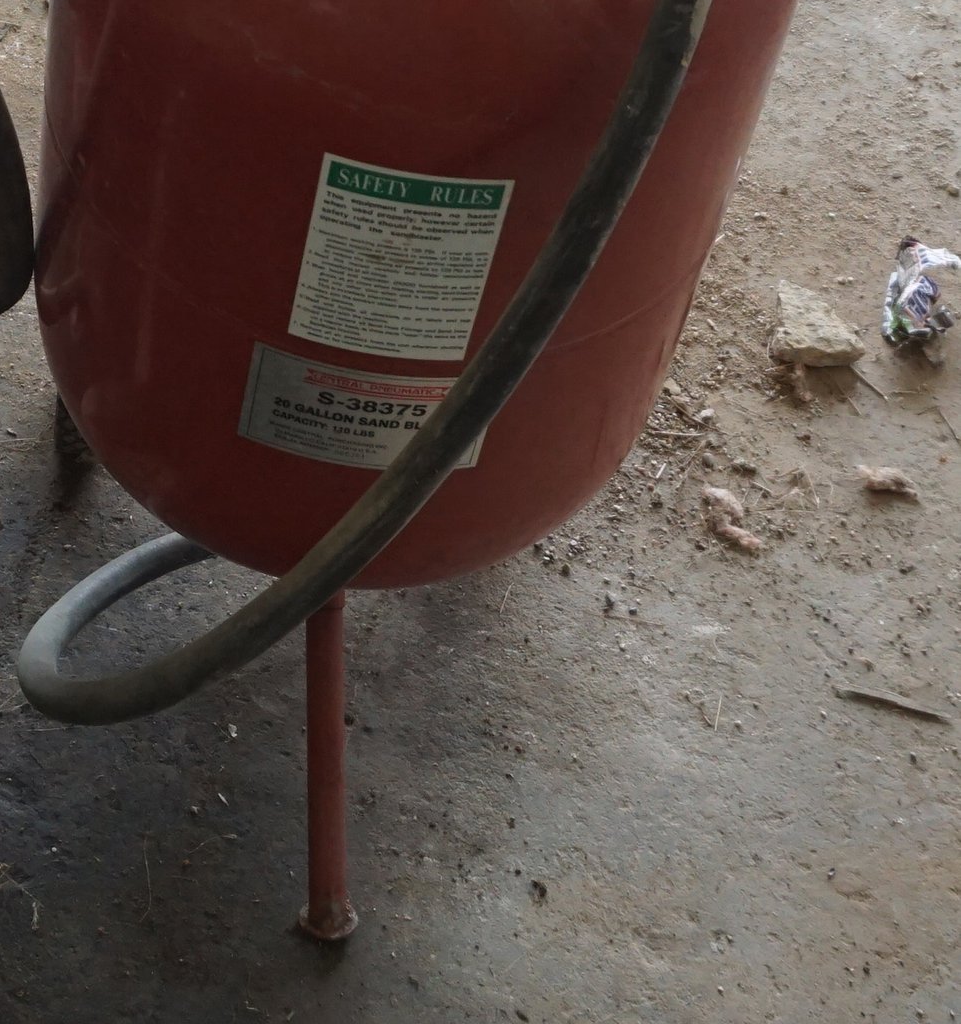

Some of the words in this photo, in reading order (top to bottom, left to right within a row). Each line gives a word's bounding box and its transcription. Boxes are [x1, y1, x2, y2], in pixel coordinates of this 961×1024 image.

[337, 168, 412, 198] SAFETY
[431, 186, 494, 206] RULES
[294, 403, 355, 424] GALLON
[359, 416, 400, 430] SAND
[404, 420, 423, 431] BL
[317, 391, 428, 417] S-38375
[272, 409, 328, 430] CAPACITY:
[353, 428, 375, 438] LBS
